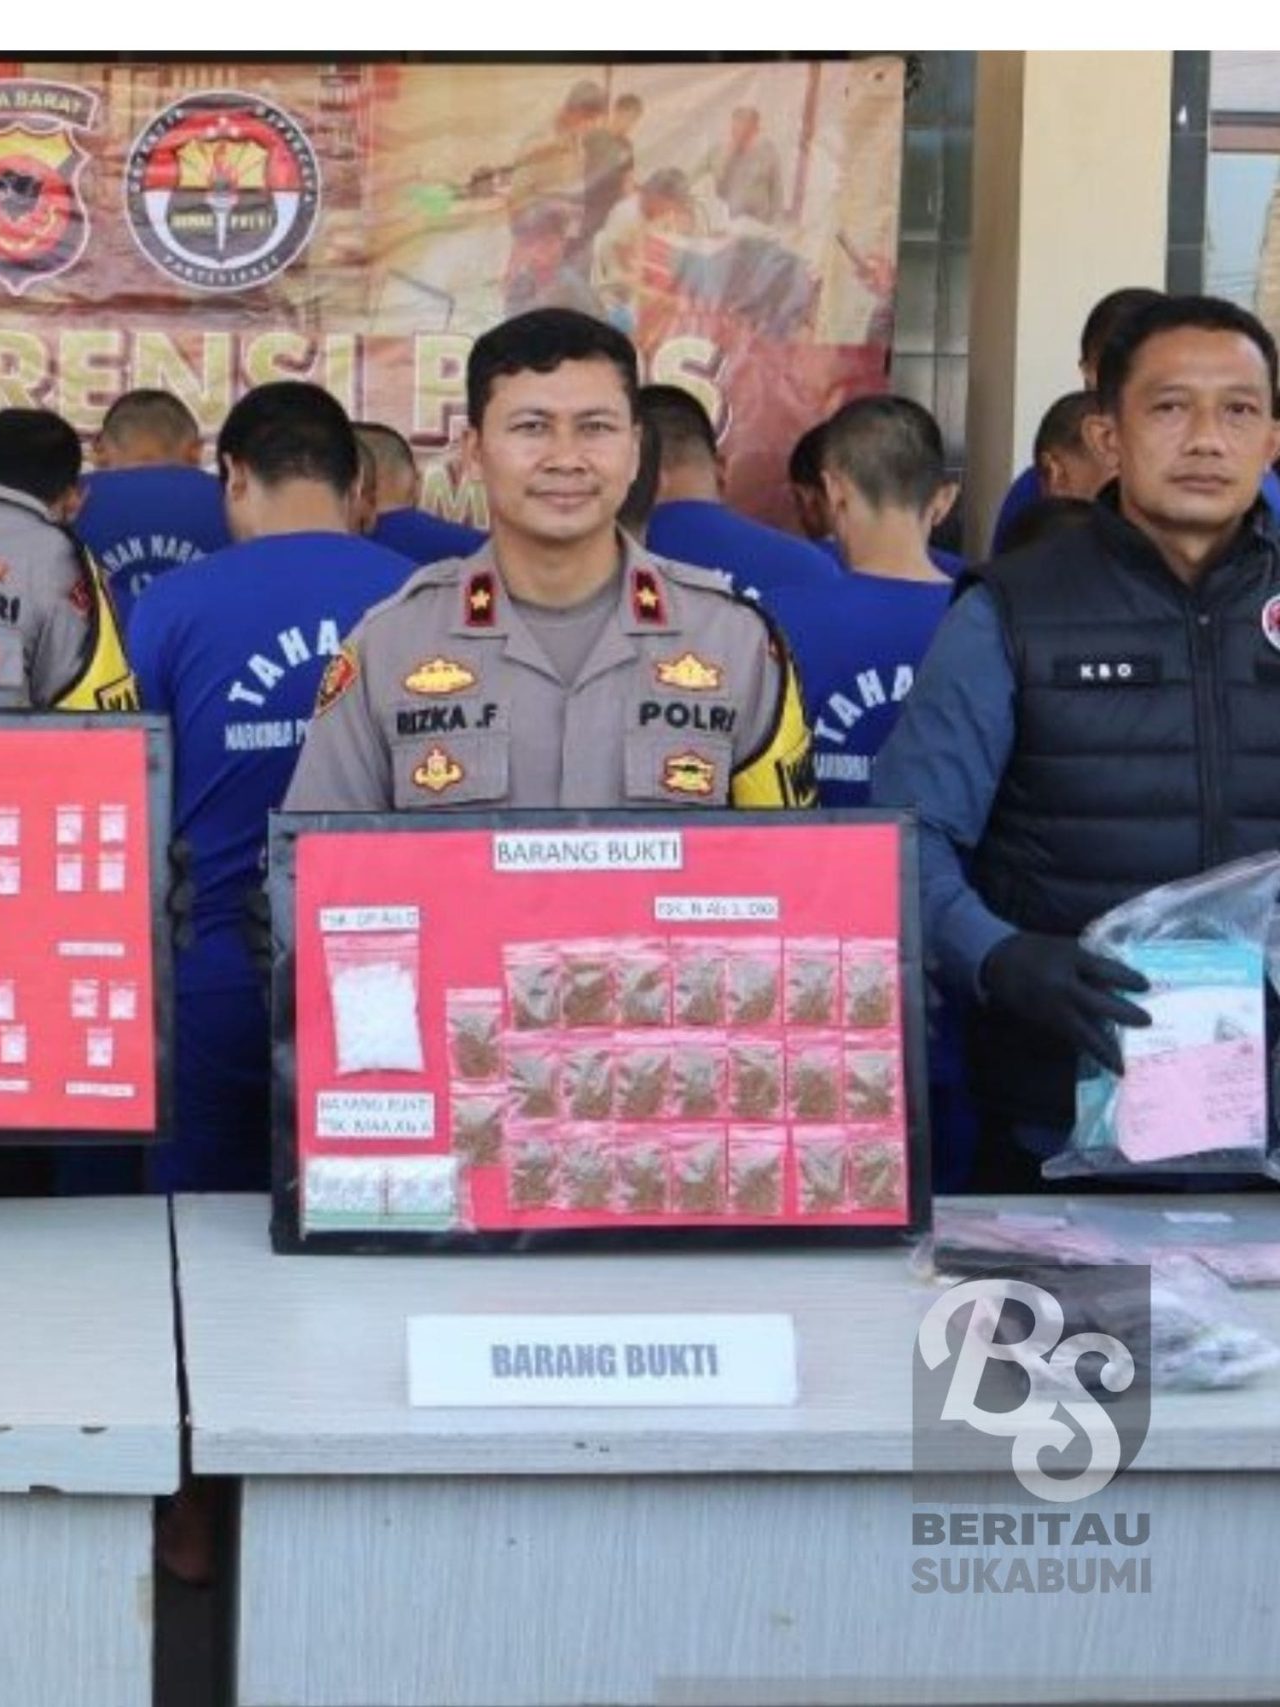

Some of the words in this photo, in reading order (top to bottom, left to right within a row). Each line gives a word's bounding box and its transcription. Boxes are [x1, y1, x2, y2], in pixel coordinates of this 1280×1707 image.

[228, 620, 340, 706] TAHA
[1080, 662, 1133, 681] KBO
[396, 705, 467, 735] RIZKA
[639, 701, 737, 733] POLRI
[814, 665, 914, 744] TAHA
[497, 840, 600, 864] BARANG
[607, 838, 678, 862] BUKTI
[490, 1343, 618, 1379] BARANG
[624, 1343, 720, 1377] BUKTI
